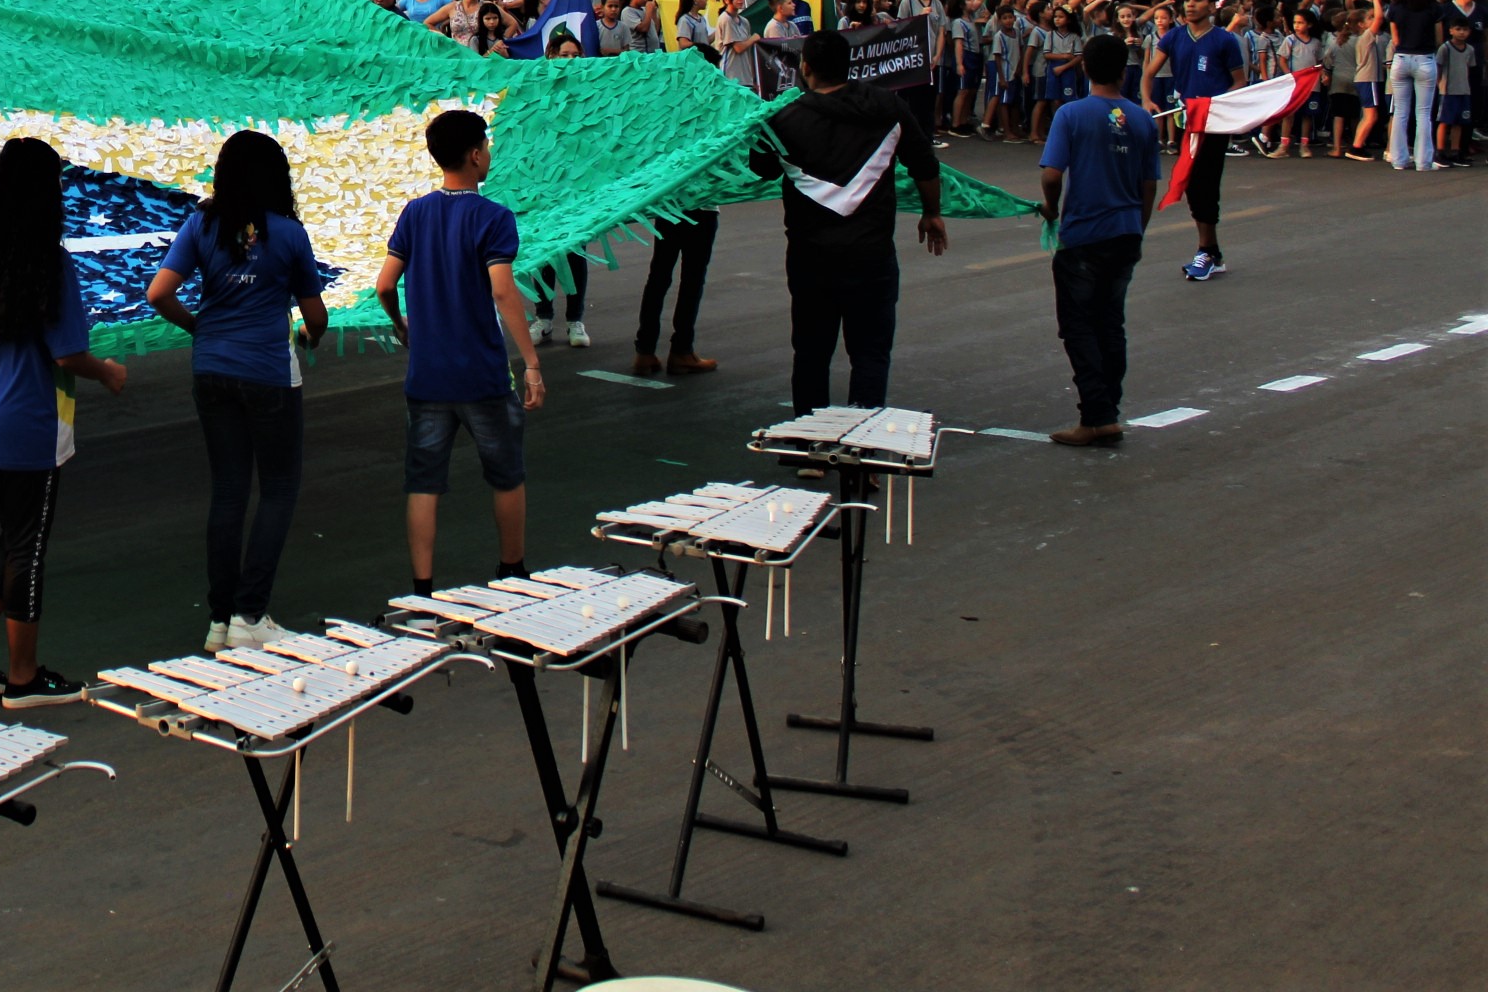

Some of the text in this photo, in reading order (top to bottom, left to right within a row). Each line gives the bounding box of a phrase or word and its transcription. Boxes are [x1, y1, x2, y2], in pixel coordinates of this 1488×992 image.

[866, 35, 919, 58] MUNICIPAL
[861, 62, 877, 78] DE
[878, 53, 924, 75] MORAES
